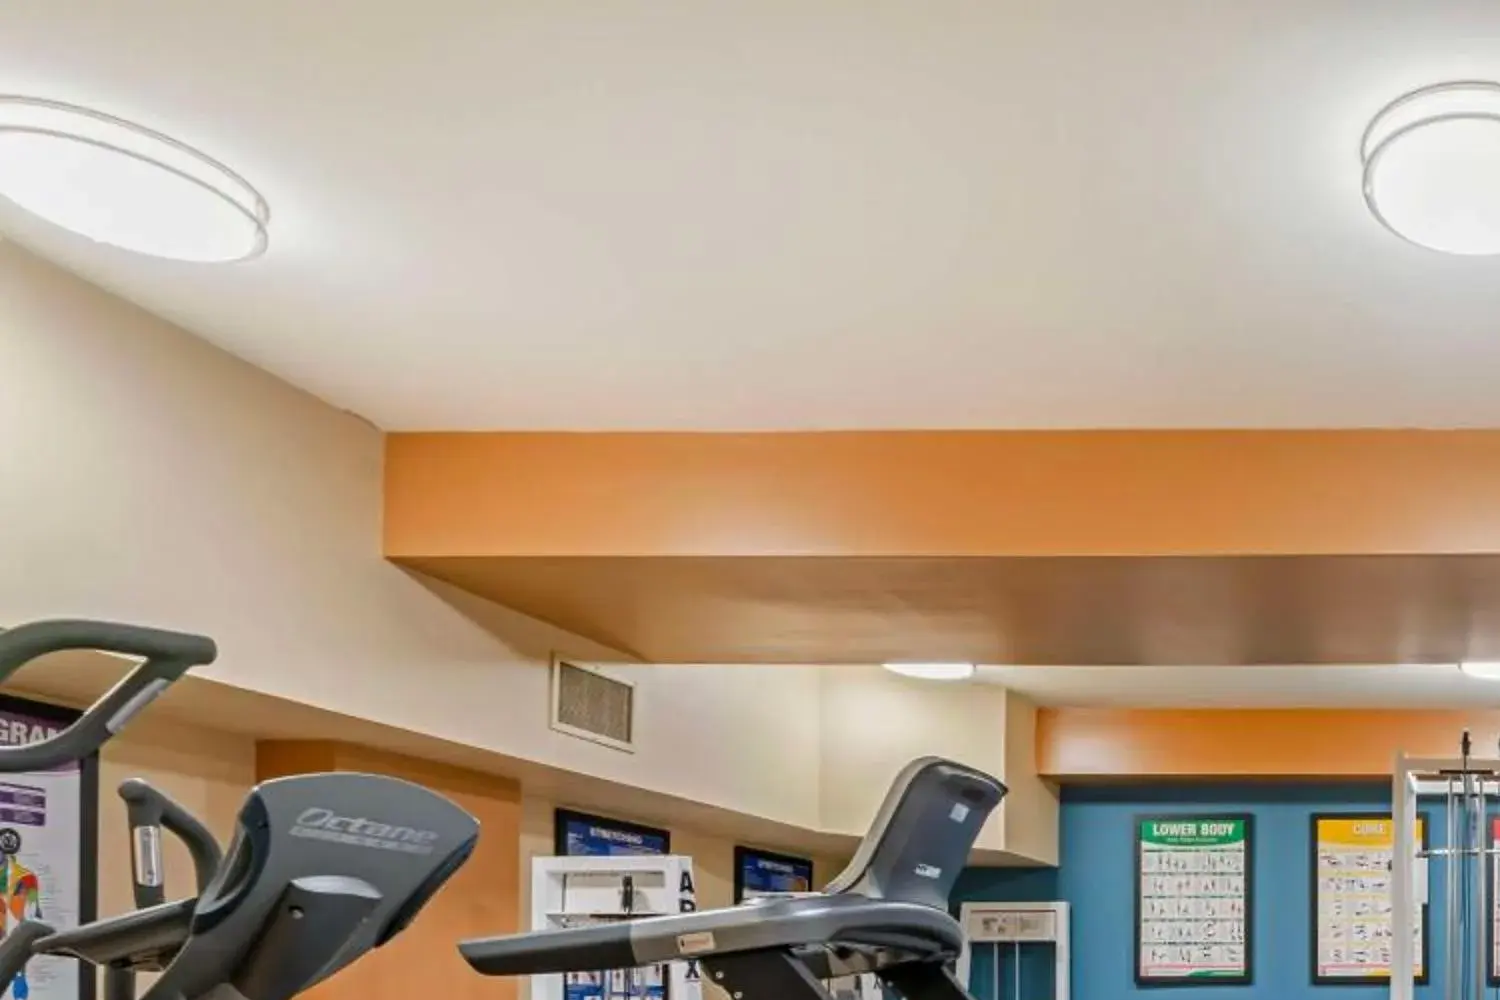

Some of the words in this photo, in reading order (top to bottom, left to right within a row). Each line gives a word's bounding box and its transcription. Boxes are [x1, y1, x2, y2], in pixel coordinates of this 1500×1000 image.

[297, 807, 439, 843] Octane
[1152, 823, 1196, 836] LOWER
[1201, 823, 1235, 836] BODY
